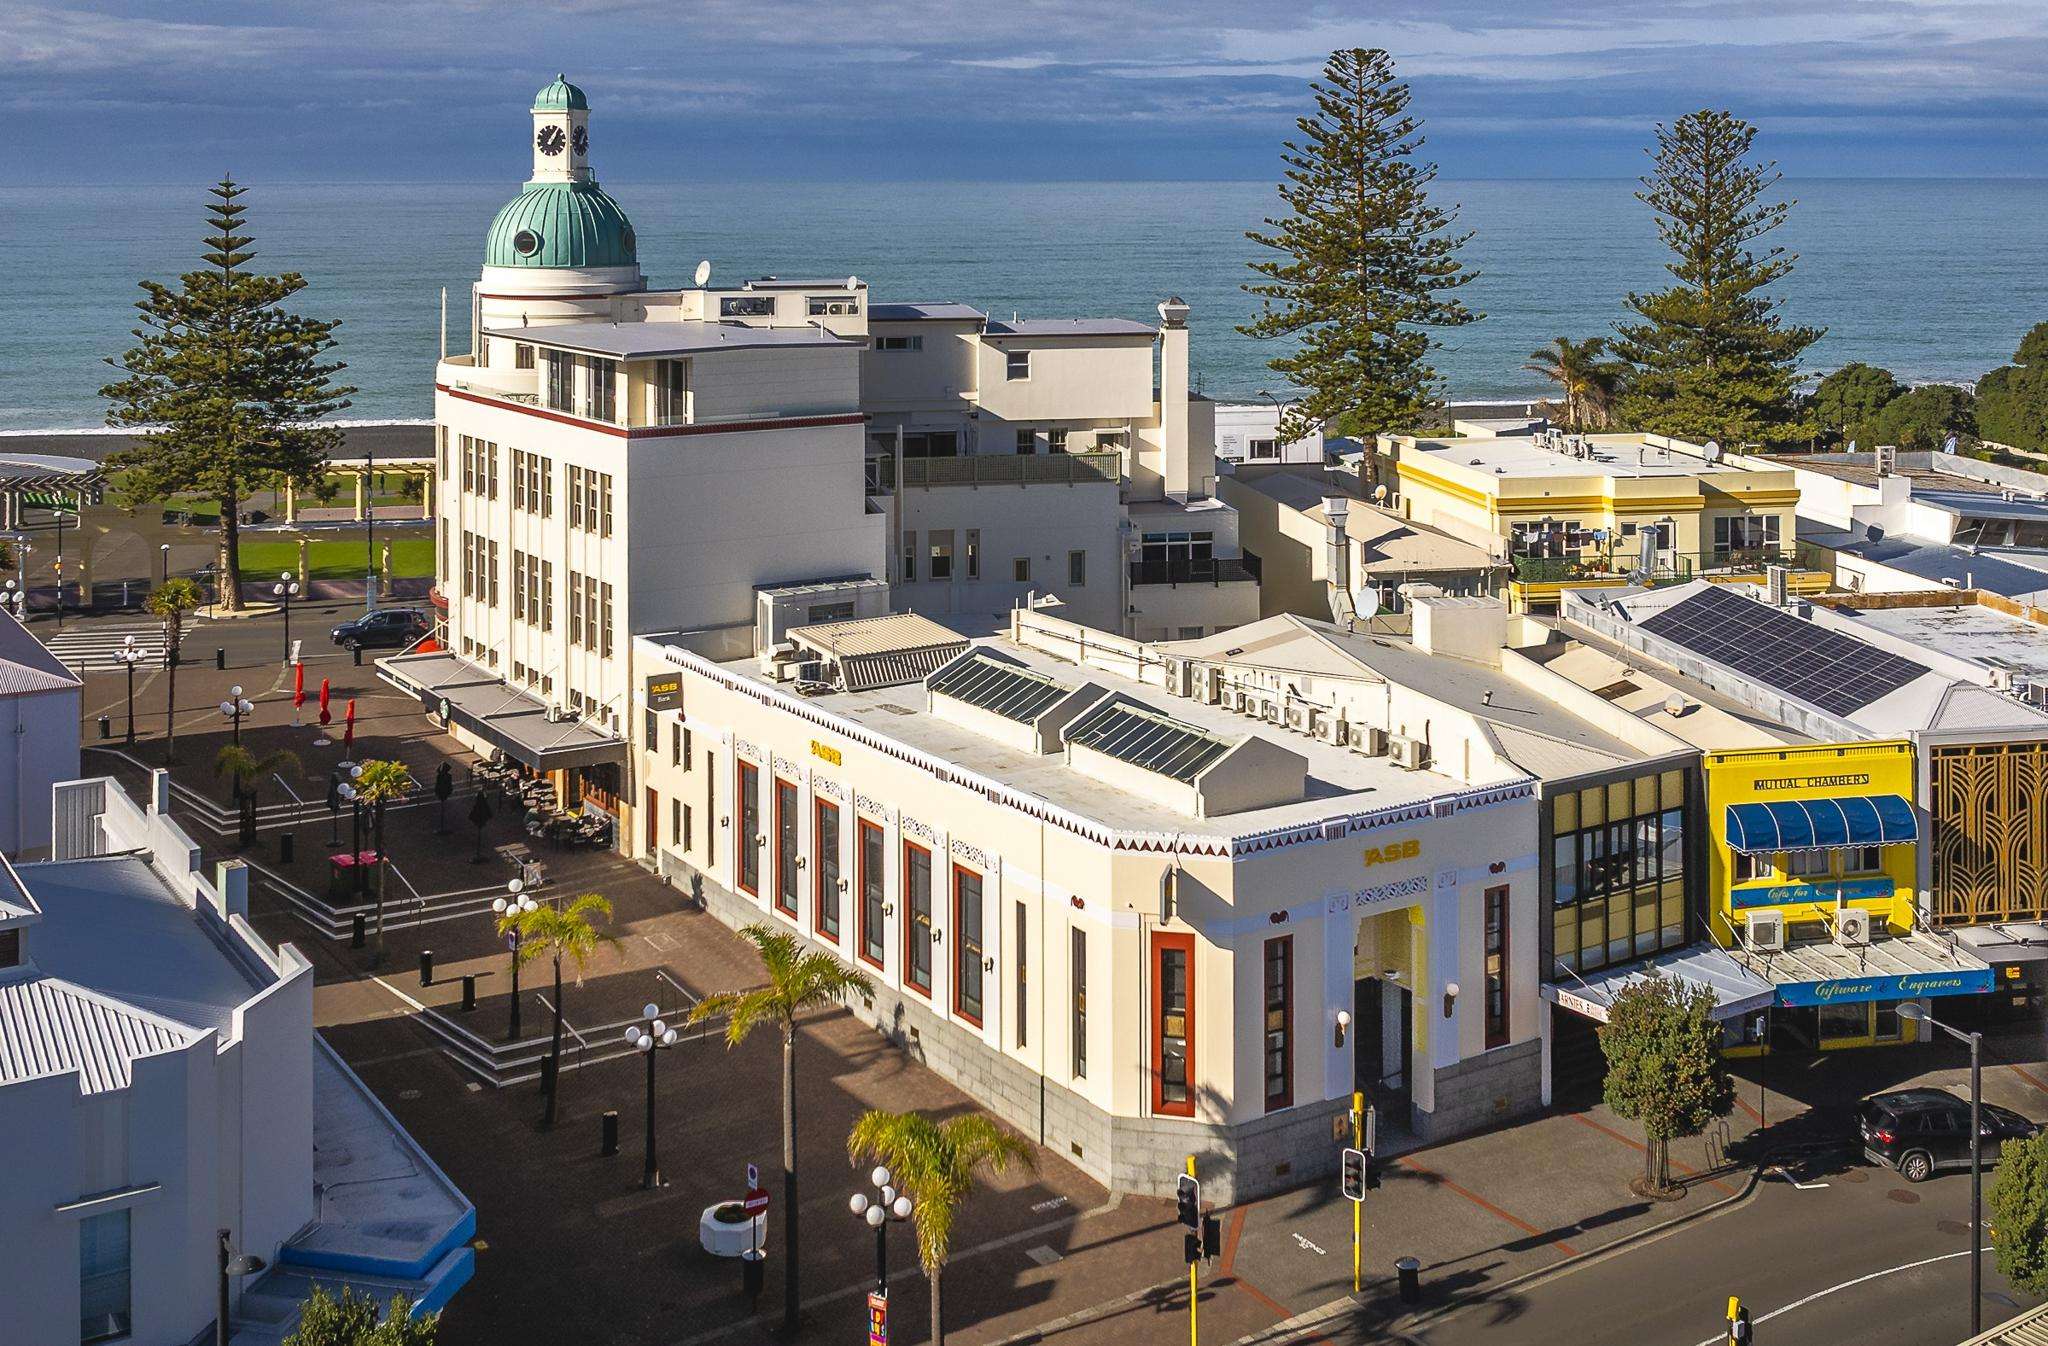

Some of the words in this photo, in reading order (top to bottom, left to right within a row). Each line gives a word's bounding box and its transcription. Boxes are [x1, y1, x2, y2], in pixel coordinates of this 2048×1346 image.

[651, 683, 678, 693] ASB
[811, 740, 842, 766] ASB
[1755, 778, 1800, 790] MUTUAL
[1807, 774, 1869, 787] CHAMBERS
[1364, 840, 1420, 867] ASB
[1815, 982, 1872, 999] Giftware
[1898, 975, 1962, 995] Engravers
